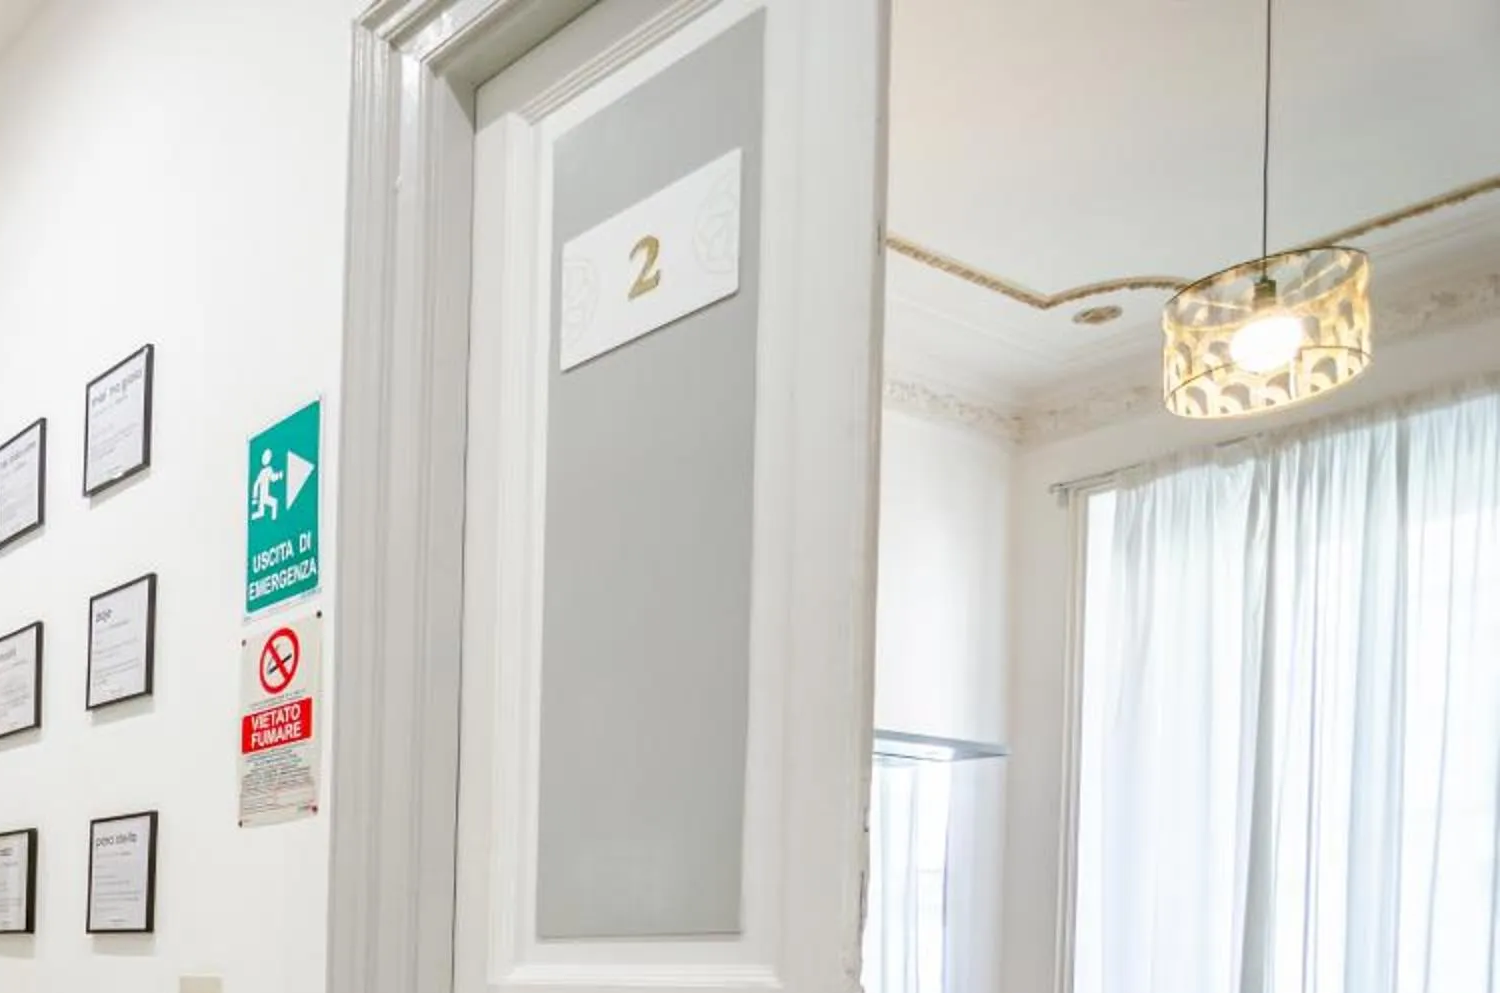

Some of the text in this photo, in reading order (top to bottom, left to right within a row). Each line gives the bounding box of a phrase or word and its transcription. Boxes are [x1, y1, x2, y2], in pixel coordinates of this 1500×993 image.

[628, 234, 661, 301] 2
[253, 531, 312, 573] USCITA DI
[249, 557, 317, 601] EMERGENZA
[251, 703, 301, 731] VIETATO
[251, 721, 302, 749] FUMARE
